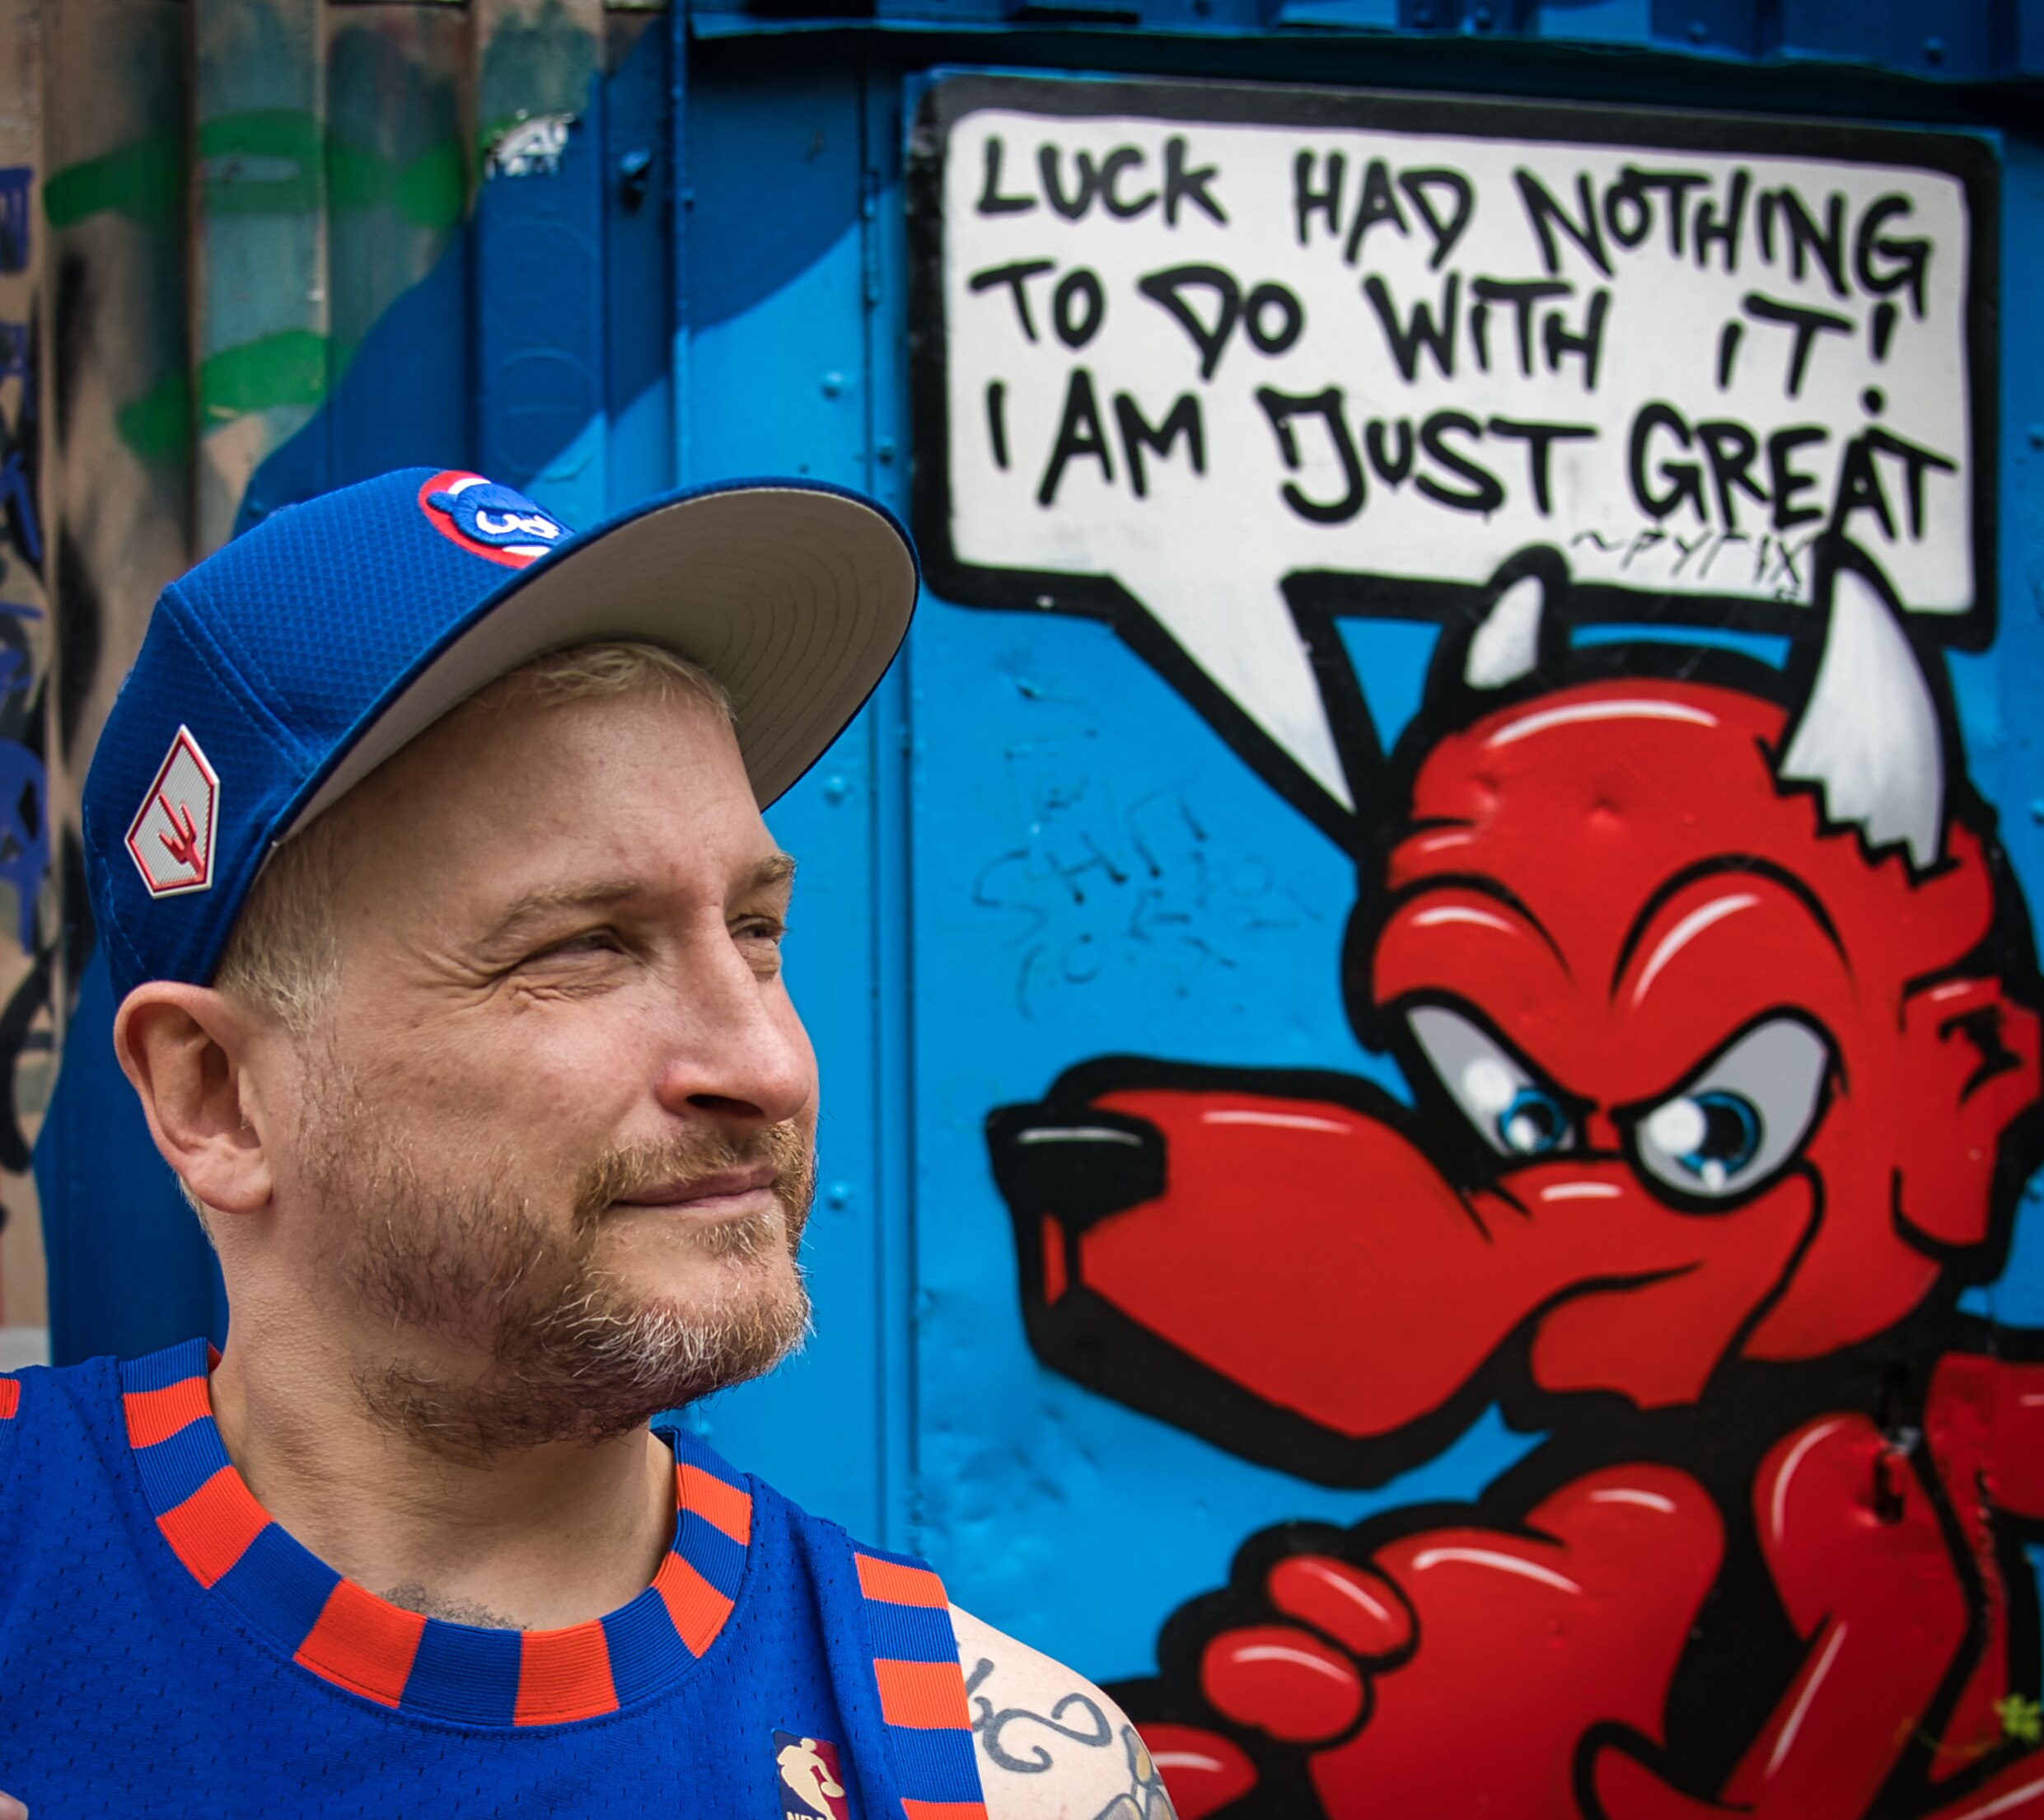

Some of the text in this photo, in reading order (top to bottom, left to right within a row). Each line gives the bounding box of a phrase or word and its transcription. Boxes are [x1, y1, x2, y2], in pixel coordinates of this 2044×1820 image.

[975, 135, 1935, 323] LUCK HAD NOTHING
[967, 258, 1107, 351] TO
[1137, 262, 1306, 382] DO
[1362, 271, 1612, 392] WITH
[985, 366, 1960, 545] I AM JUST GREAT
